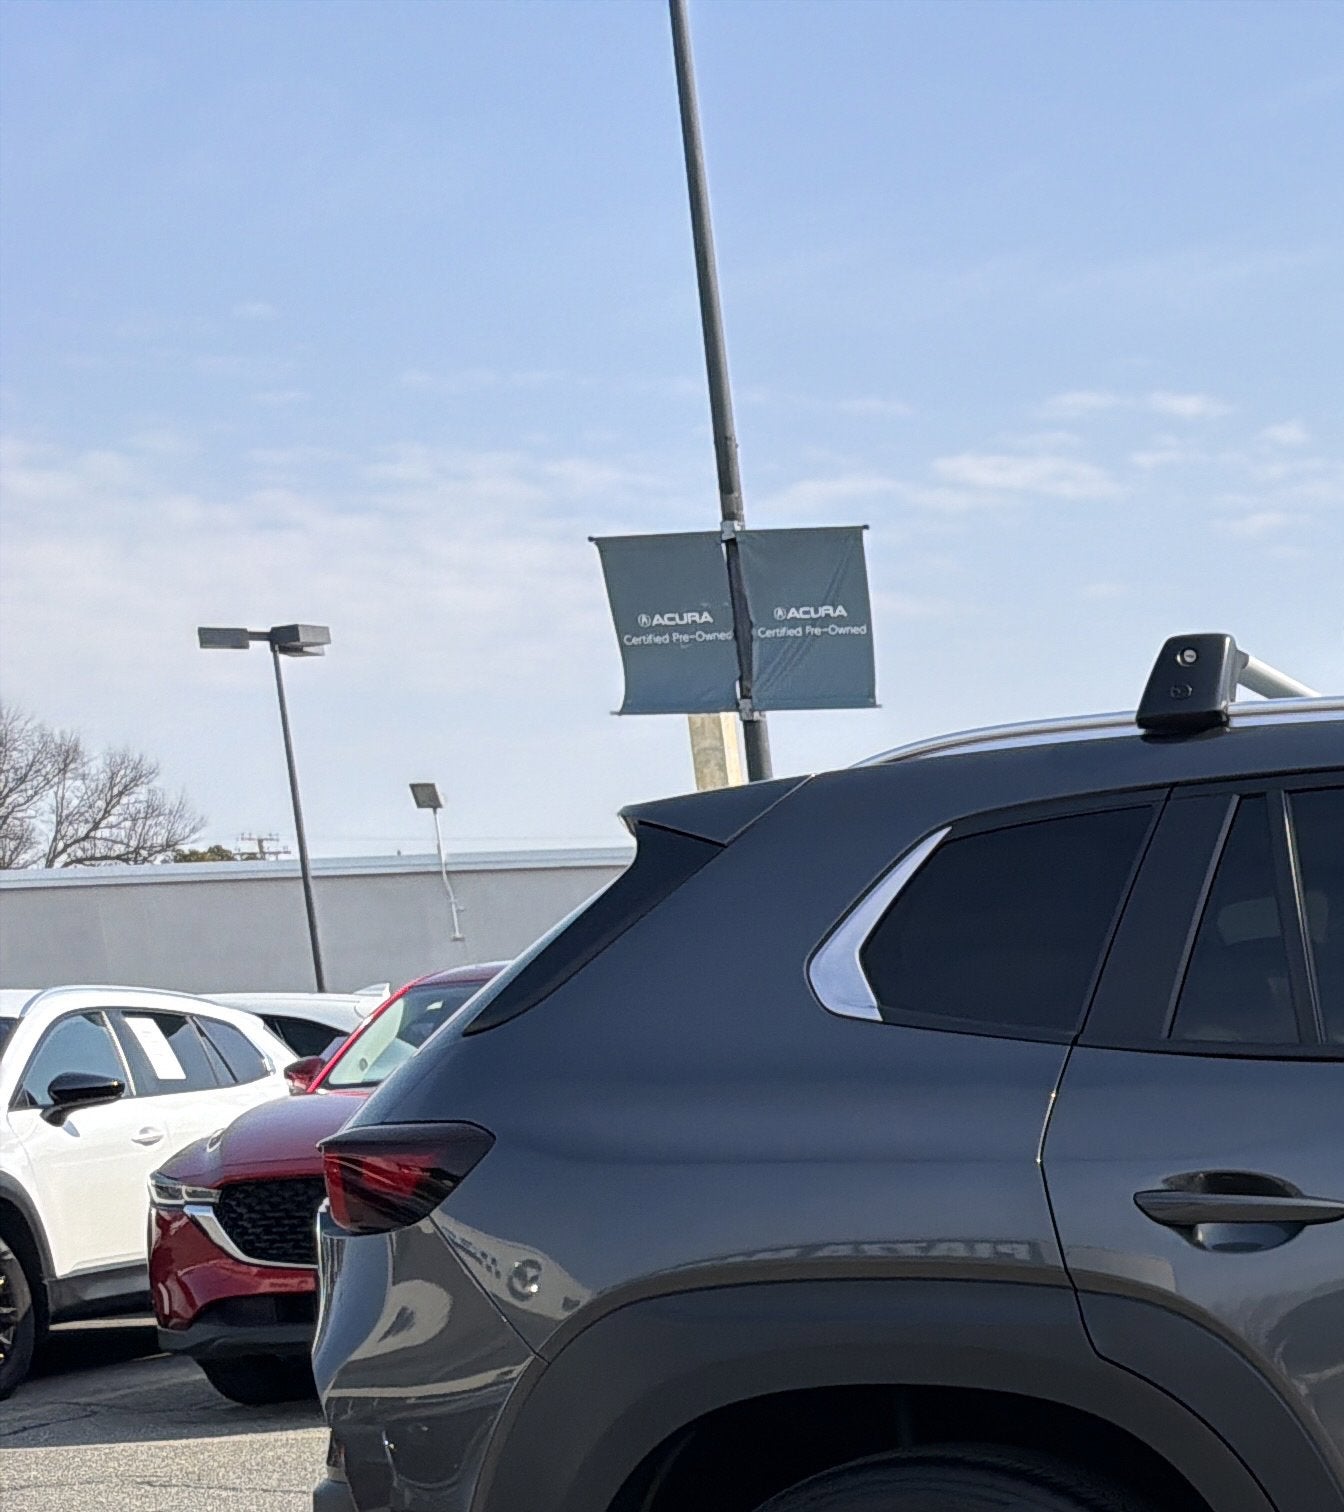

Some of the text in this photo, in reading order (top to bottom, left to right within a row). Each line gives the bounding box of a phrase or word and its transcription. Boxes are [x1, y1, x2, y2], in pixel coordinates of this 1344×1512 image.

[652, 611, 714, 626] ACURA
[786, 605, 848, 620] ACURA
[623, 630, 733, 646] Certified Pre-Owned
[757, 624, 867, 638] Certified Pre-Owned
